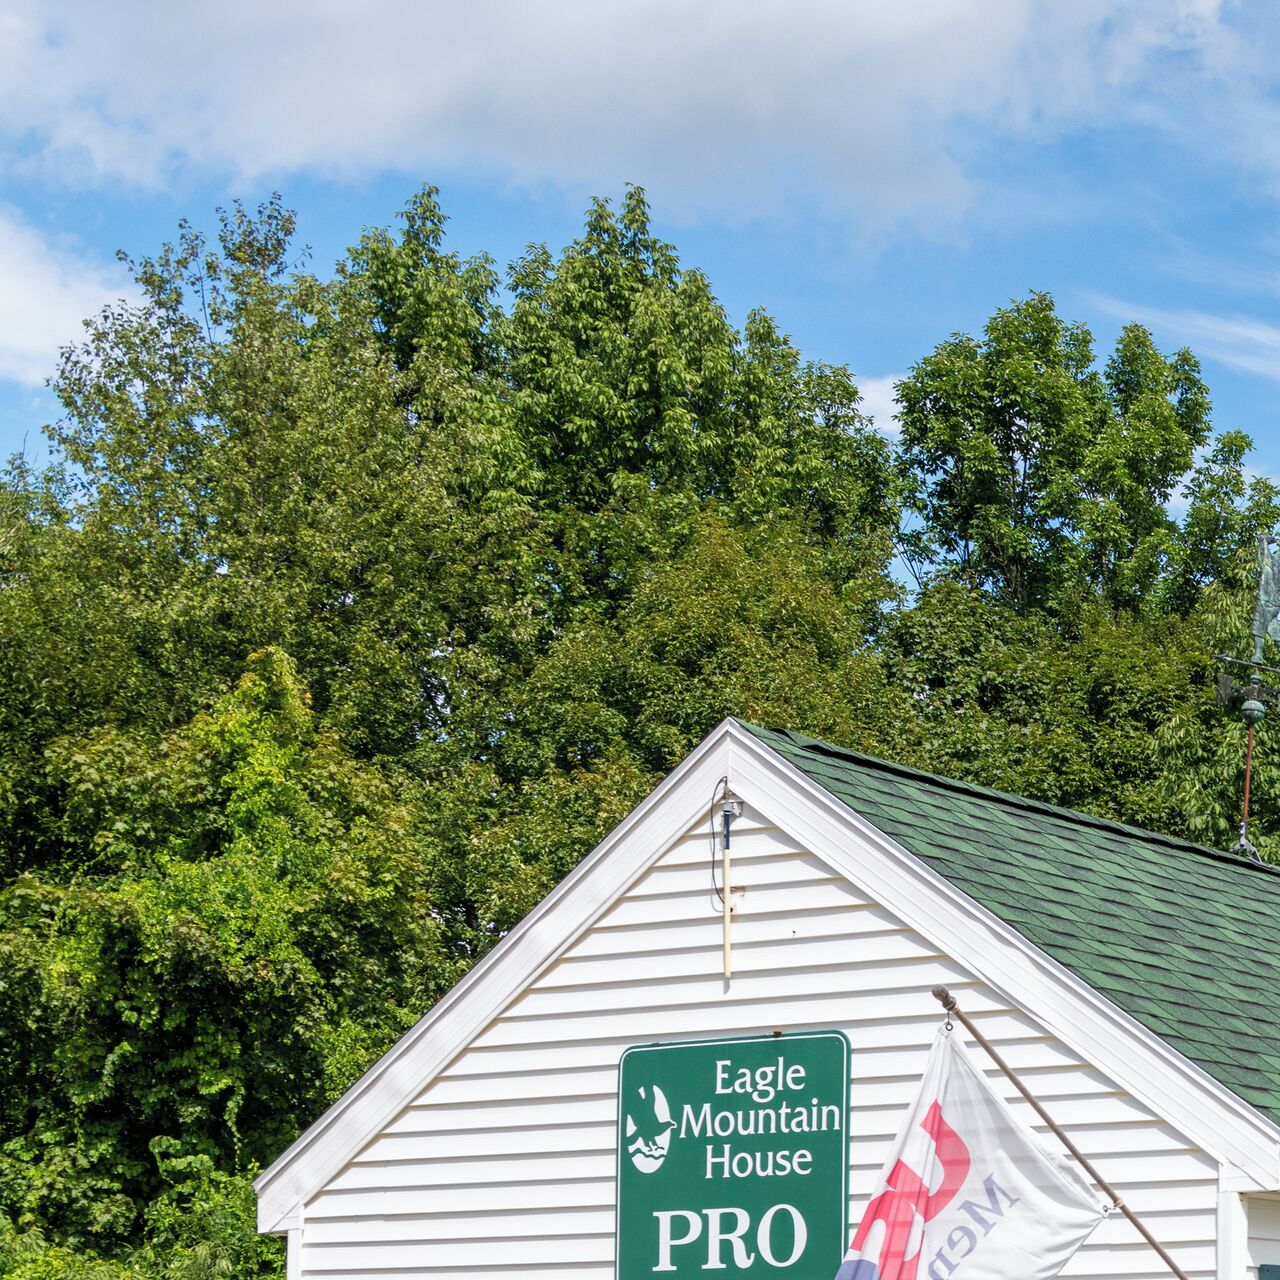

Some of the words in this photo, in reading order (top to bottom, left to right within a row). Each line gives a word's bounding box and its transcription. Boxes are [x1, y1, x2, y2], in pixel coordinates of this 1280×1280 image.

[715, 1056, 806, 1103] Eagle
[679, 1097, 841, 1138] Mountain
[705, 1144, 813, 1179] House
[652, 1203, 808, 1272] PRO
